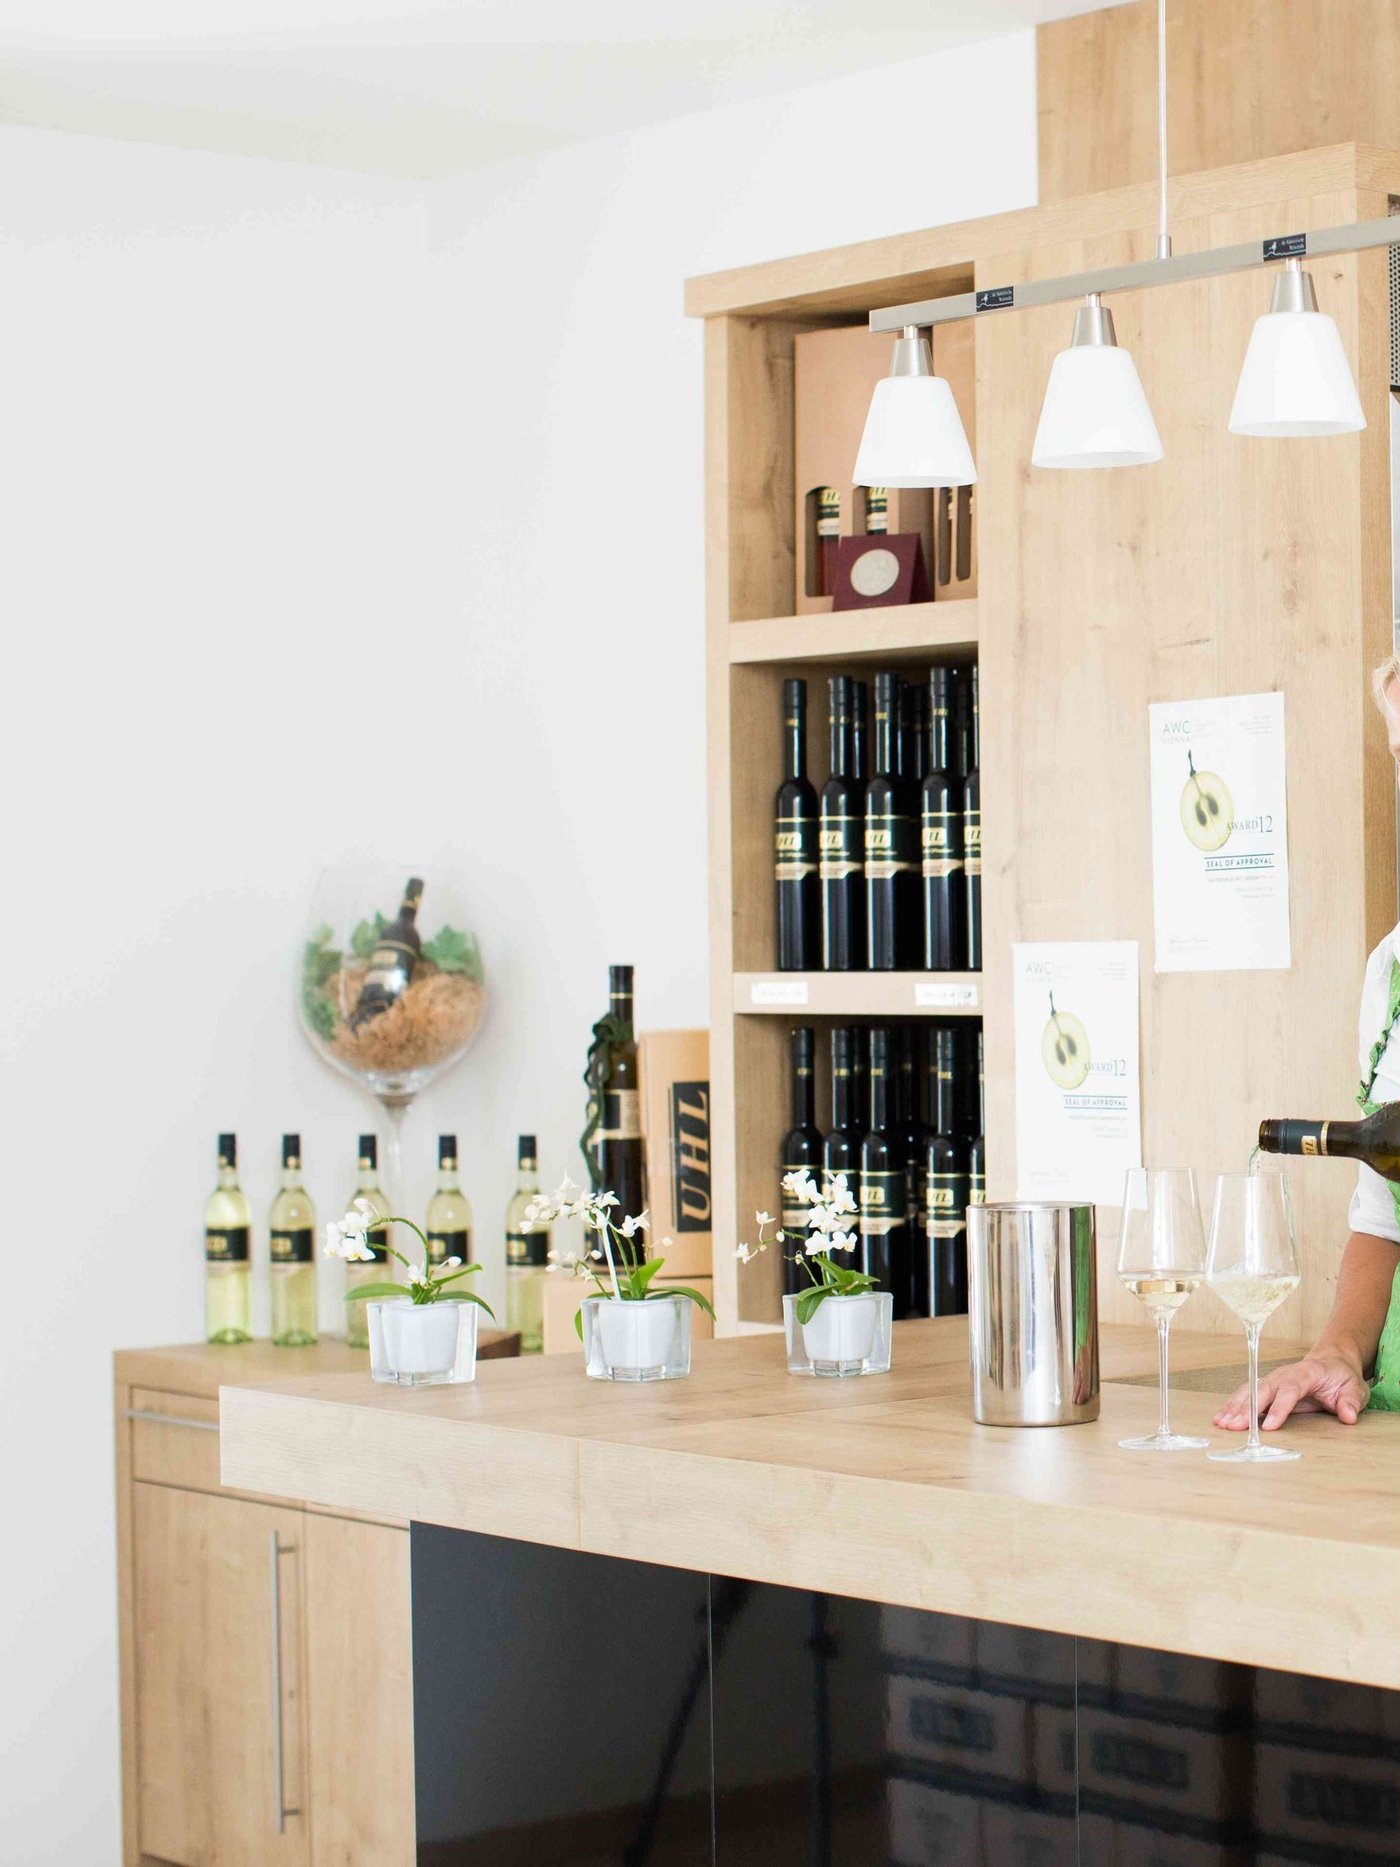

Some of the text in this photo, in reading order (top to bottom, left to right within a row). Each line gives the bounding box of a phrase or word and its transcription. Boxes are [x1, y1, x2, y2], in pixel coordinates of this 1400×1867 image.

[1163, 720, 1190, 735] AWC
[1206, 857, 1273, 868] SEAL OF APPROVAL
[679, 1089, 711, 1222] UHL
